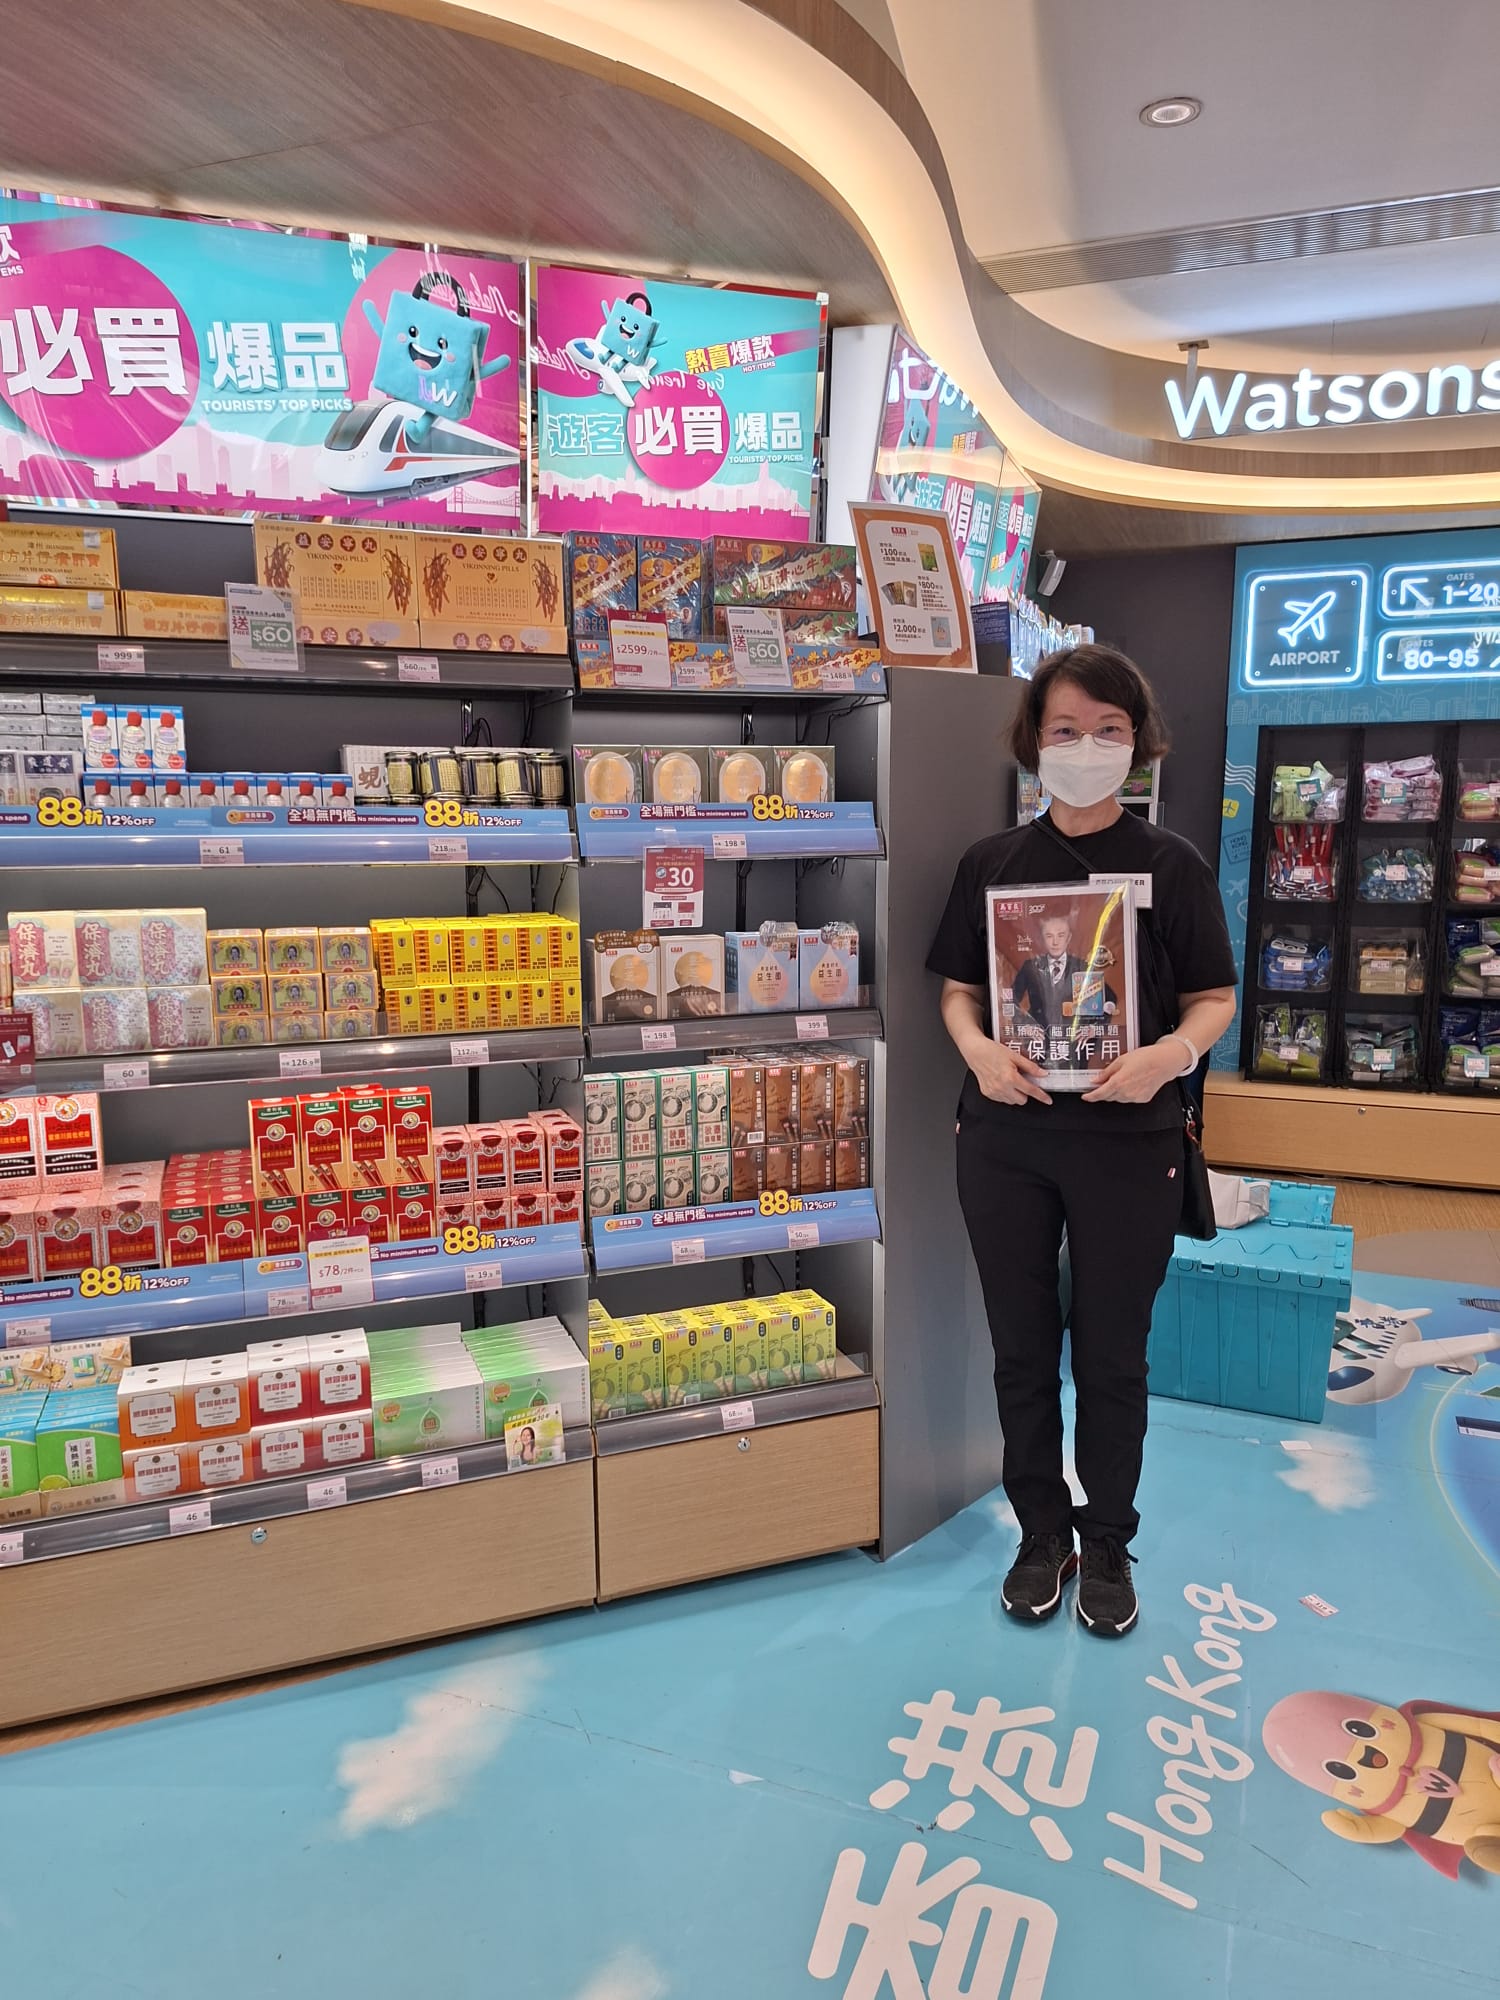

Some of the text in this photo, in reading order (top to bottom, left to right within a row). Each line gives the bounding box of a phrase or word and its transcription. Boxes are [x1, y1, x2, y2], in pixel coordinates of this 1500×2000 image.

[0, 305, 347, 396] 必買 爆品
[684, 335, 777, 374] 熱賣爆款
[742, 361, 776, 373] HOT ITEMS
[202, 398, 353, 412] TOURISTS' TOP PICKS
[1164, 360, 1500, 439] Watsons
[548, 404, 803, 457] 遊客 必買 爆品
[768, 454, 782, 463] TOP
[783, 454, 803, 463] PICKS
[881, 548, 898, 556] $100
[919, 581, 935, 589] $800
[1447, 573, 1475, 581] GATES
[252, 626, 292, 643] $60
[113, 651, 133, 661] 999
[749, 643, 779, 658] $60
[1270, 650, 1340, 666] AIRPORT
[1404, 648, 1479, 670] 80-95
[38, 797, 103, 827] 88折
[288, 808, 356, 822] 全場無門檻
[397, 816, 416, 824] spend
[425, 801, 479, 828] 88折
[641, 805, 696, 818] 全場無門檻
[753, 795, 799, 820] 88折
[219, 846, 230, 854] 61
[668, 867, 694, 886] 30
[17, 922, 40, 977] 保濟丸
[82, 922, 106, 977] 保濟丸
[457, 1047, 470, 1056] 112
[122, 1069, 135, 1078] 60
[653, 1208, 706, 1226] 全場無門檻
[760, 1190, 803, 1216] 88折
[391, 1249, 417, 1258] minimum
[418, 1246, 436, 1256] spend
[444, 1226, 496, 1254] 88折
[16, 1292, 48, 1300] minimum
[49, 1288, 71, 1297] spend
[80, 1266, 141, 1297] 88折
[323, 1487, 334, 1496] 46
[187, 1512, 198, 1521] 46
[1103, 1582, 1277, 1909] Hong Kong
